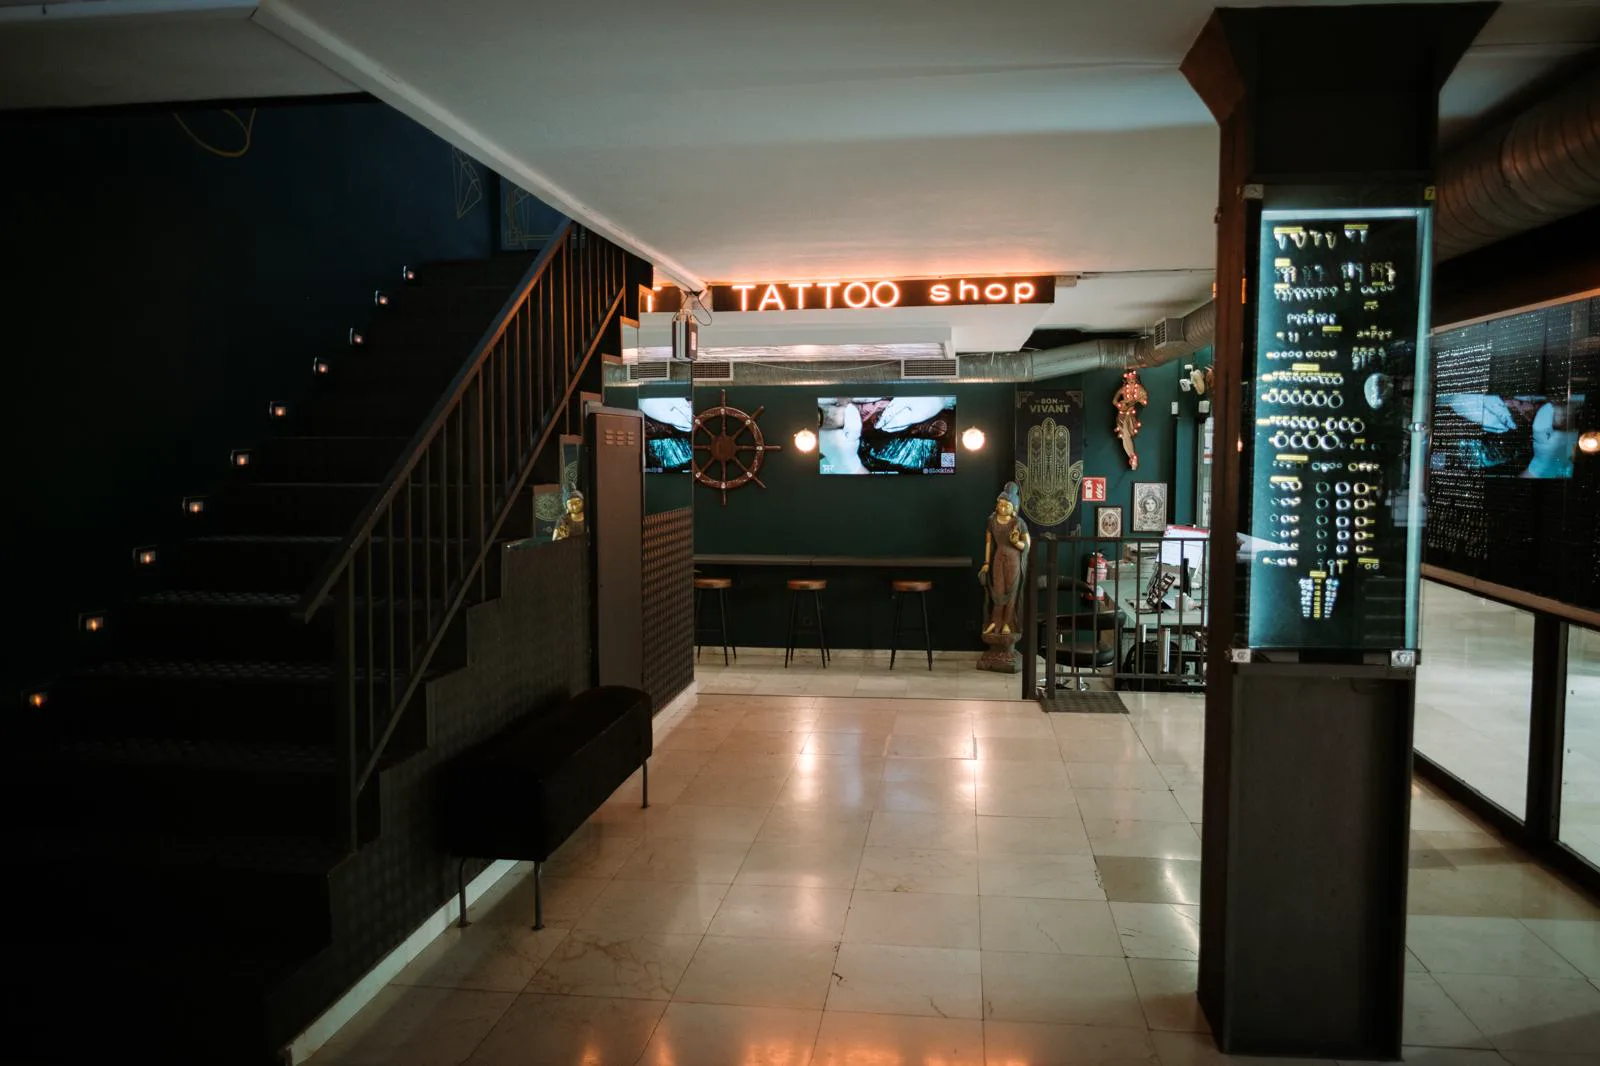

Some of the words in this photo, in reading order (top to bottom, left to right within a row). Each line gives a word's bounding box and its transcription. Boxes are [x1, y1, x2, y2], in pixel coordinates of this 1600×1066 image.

[731, 281, 899, 311] TATTOO
[930, 280, 1036, 303] shop
[1030, 404, 1070, 413] VIVANT
